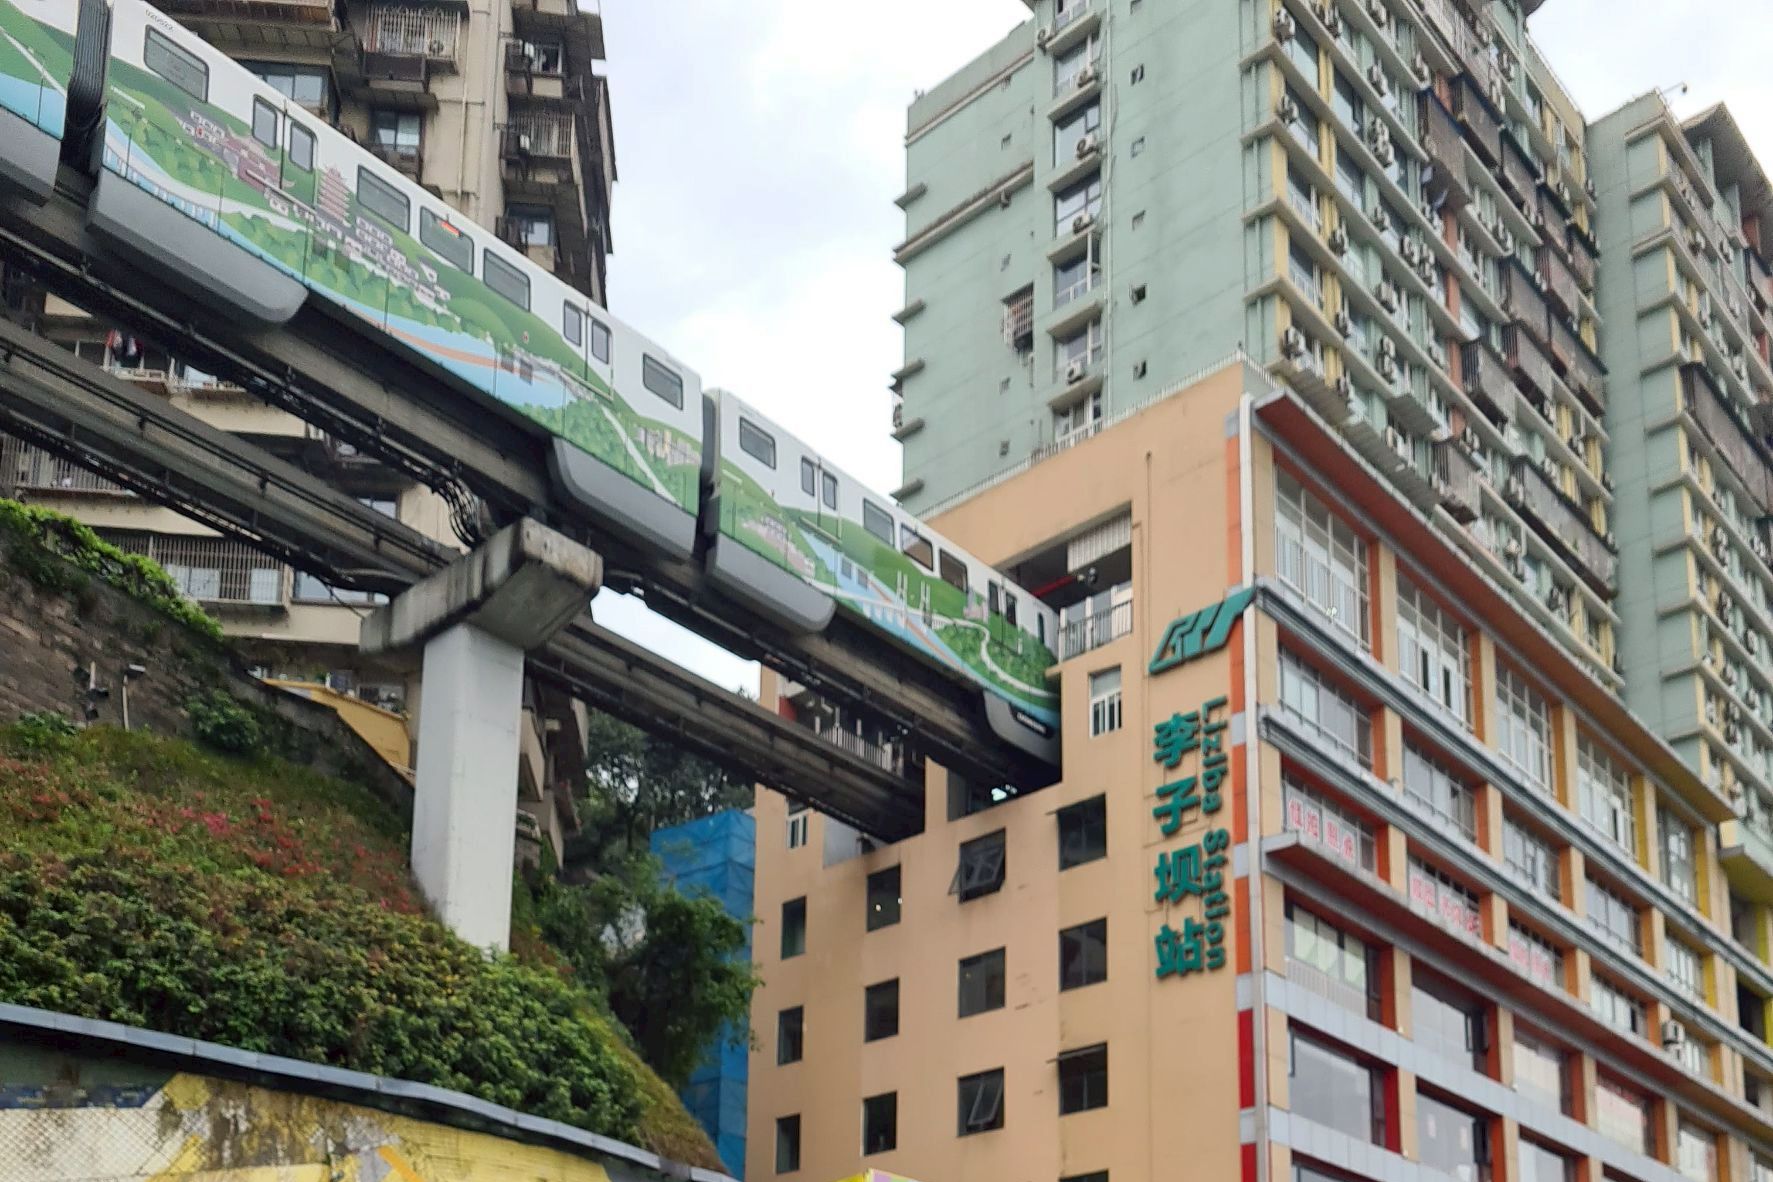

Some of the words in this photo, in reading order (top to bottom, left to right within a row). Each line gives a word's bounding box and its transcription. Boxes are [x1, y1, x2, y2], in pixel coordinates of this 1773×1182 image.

[1152, 710, 1204, 980] 李子坝站
[1202, 826, 1230, 972] Station
